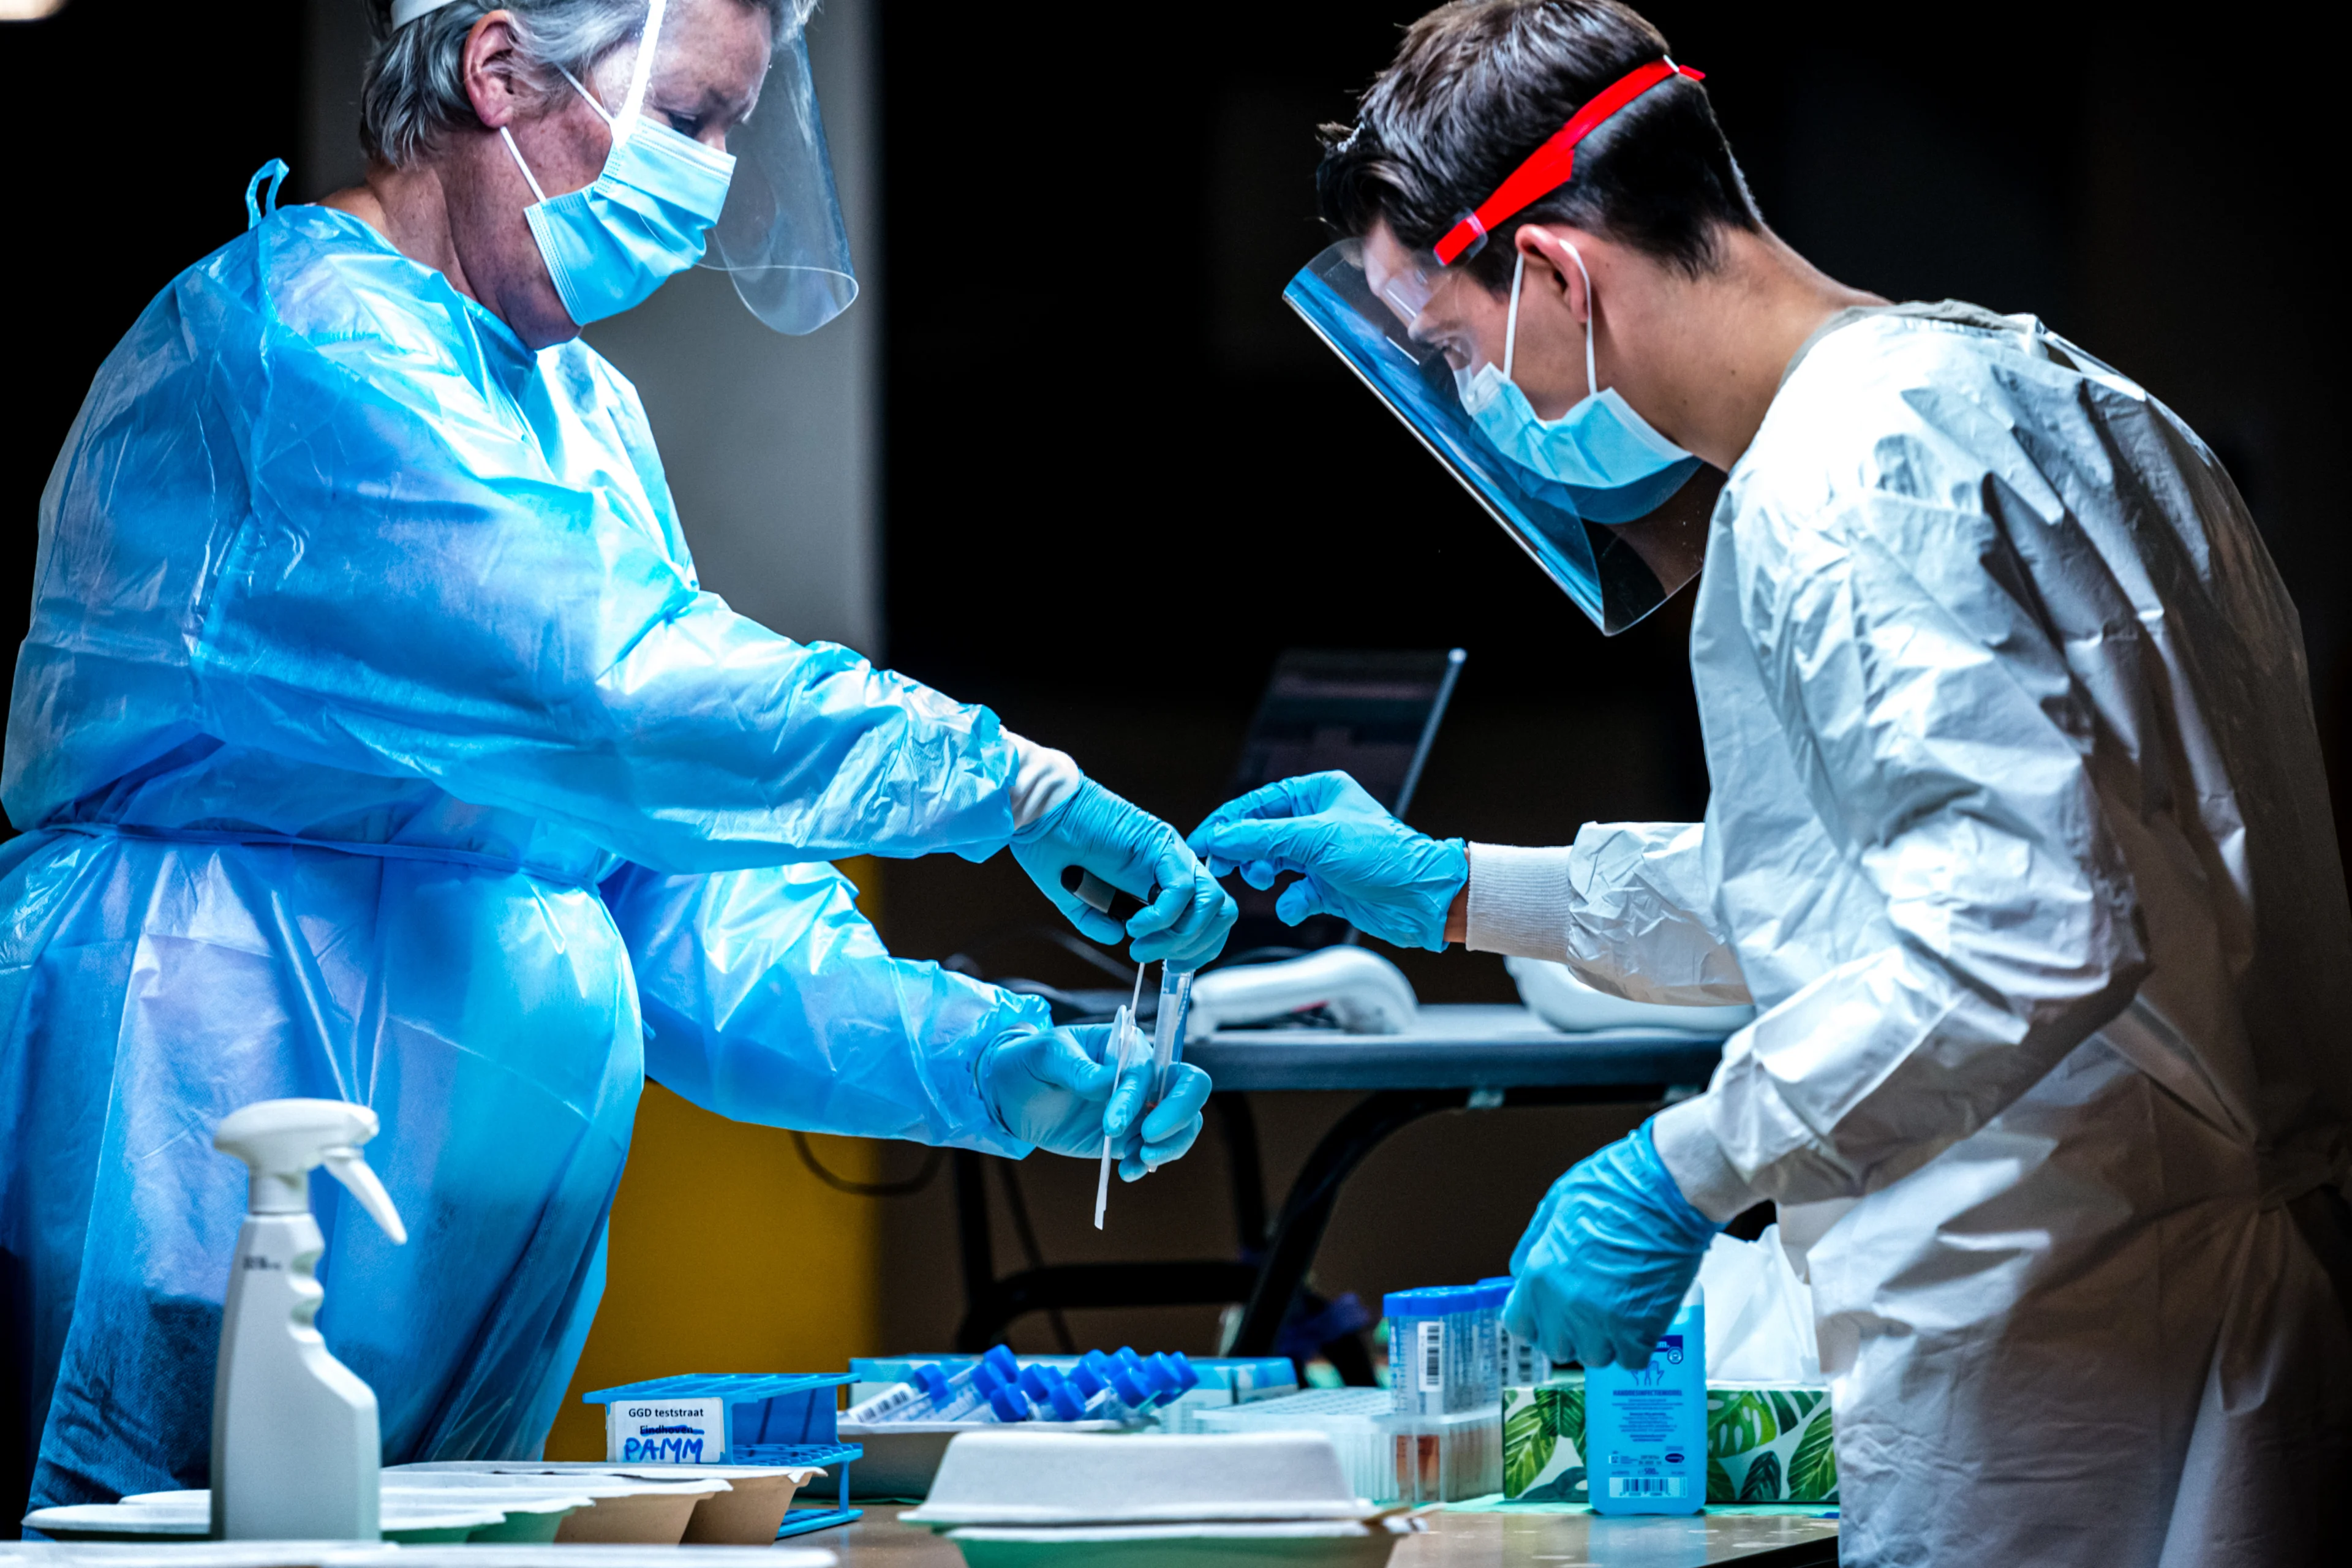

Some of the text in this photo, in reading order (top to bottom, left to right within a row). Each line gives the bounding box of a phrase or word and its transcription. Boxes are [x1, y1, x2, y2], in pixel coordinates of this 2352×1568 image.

[628, 1408, 704, 1417] GGD teststraat
[640, 1425, 693, 1434] Eindhoven
[624, 1437, 704, 1464] PAMM
